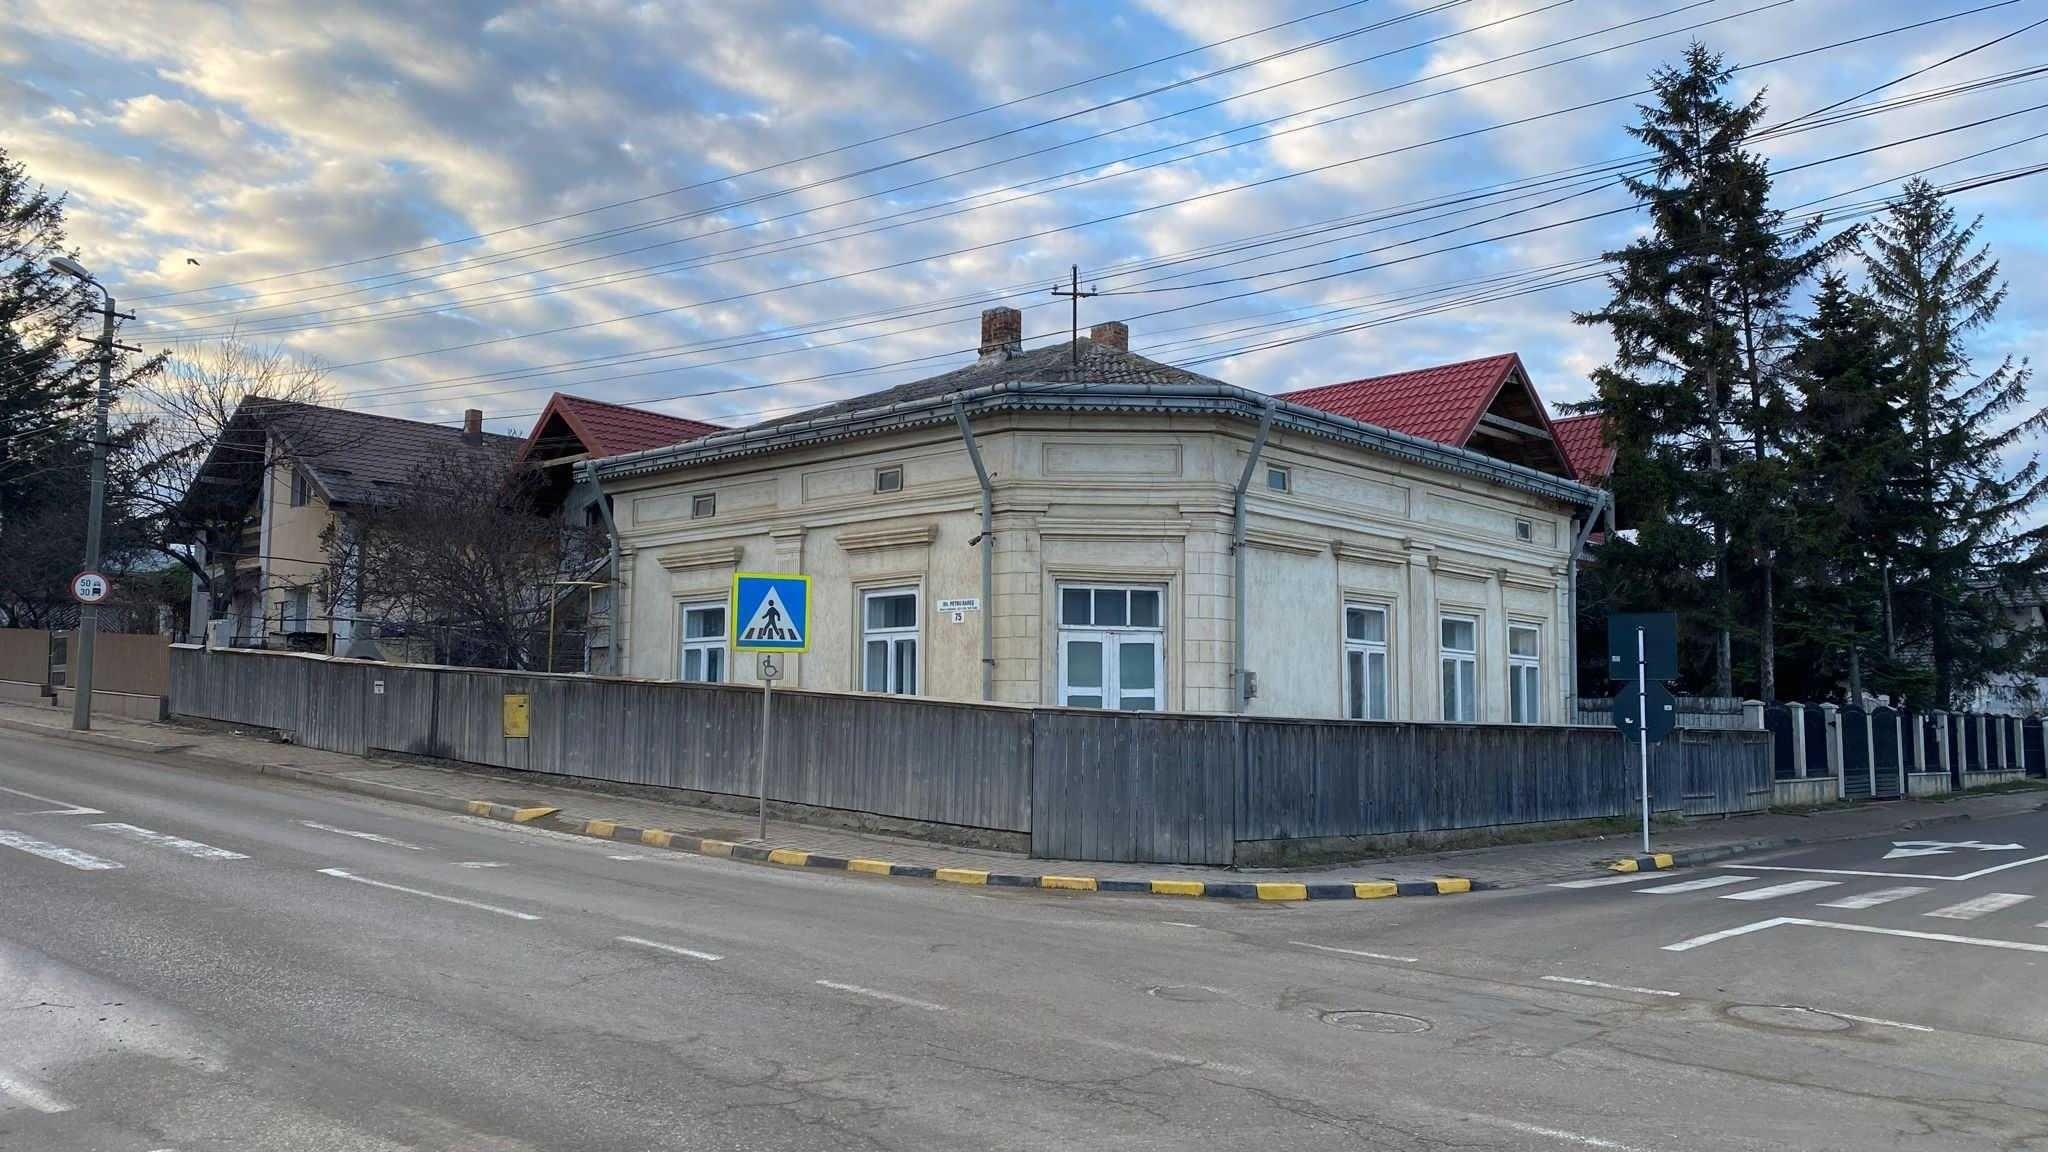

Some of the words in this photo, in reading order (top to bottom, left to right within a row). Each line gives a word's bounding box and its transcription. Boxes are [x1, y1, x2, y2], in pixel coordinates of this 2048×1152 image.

[80, 579, 91, 587] 50
[80, 588, 90, 596] 30
[955, 612, 962, 621] 75
